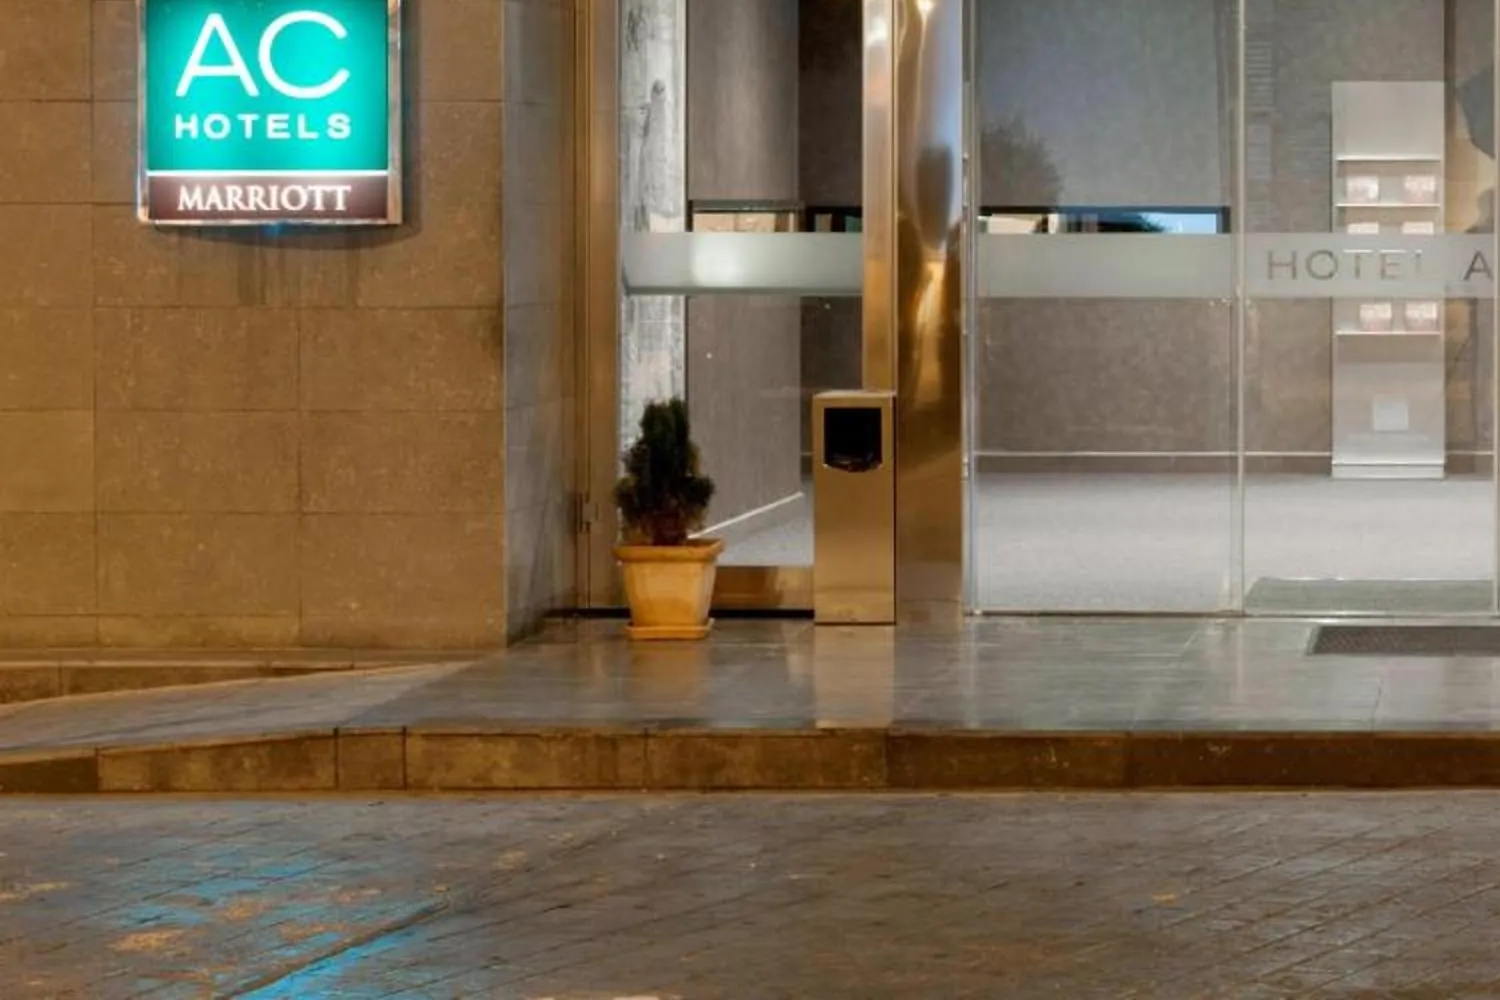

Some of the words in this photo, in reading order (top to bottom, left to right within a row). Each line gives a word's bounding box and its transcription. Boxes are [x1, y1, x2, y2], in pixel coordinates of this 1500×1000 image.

[175, 10, 351, 100] AC
[174, 112, 352, 140] HOTELS
[176, 184, 352, 212] MARRIOTT
